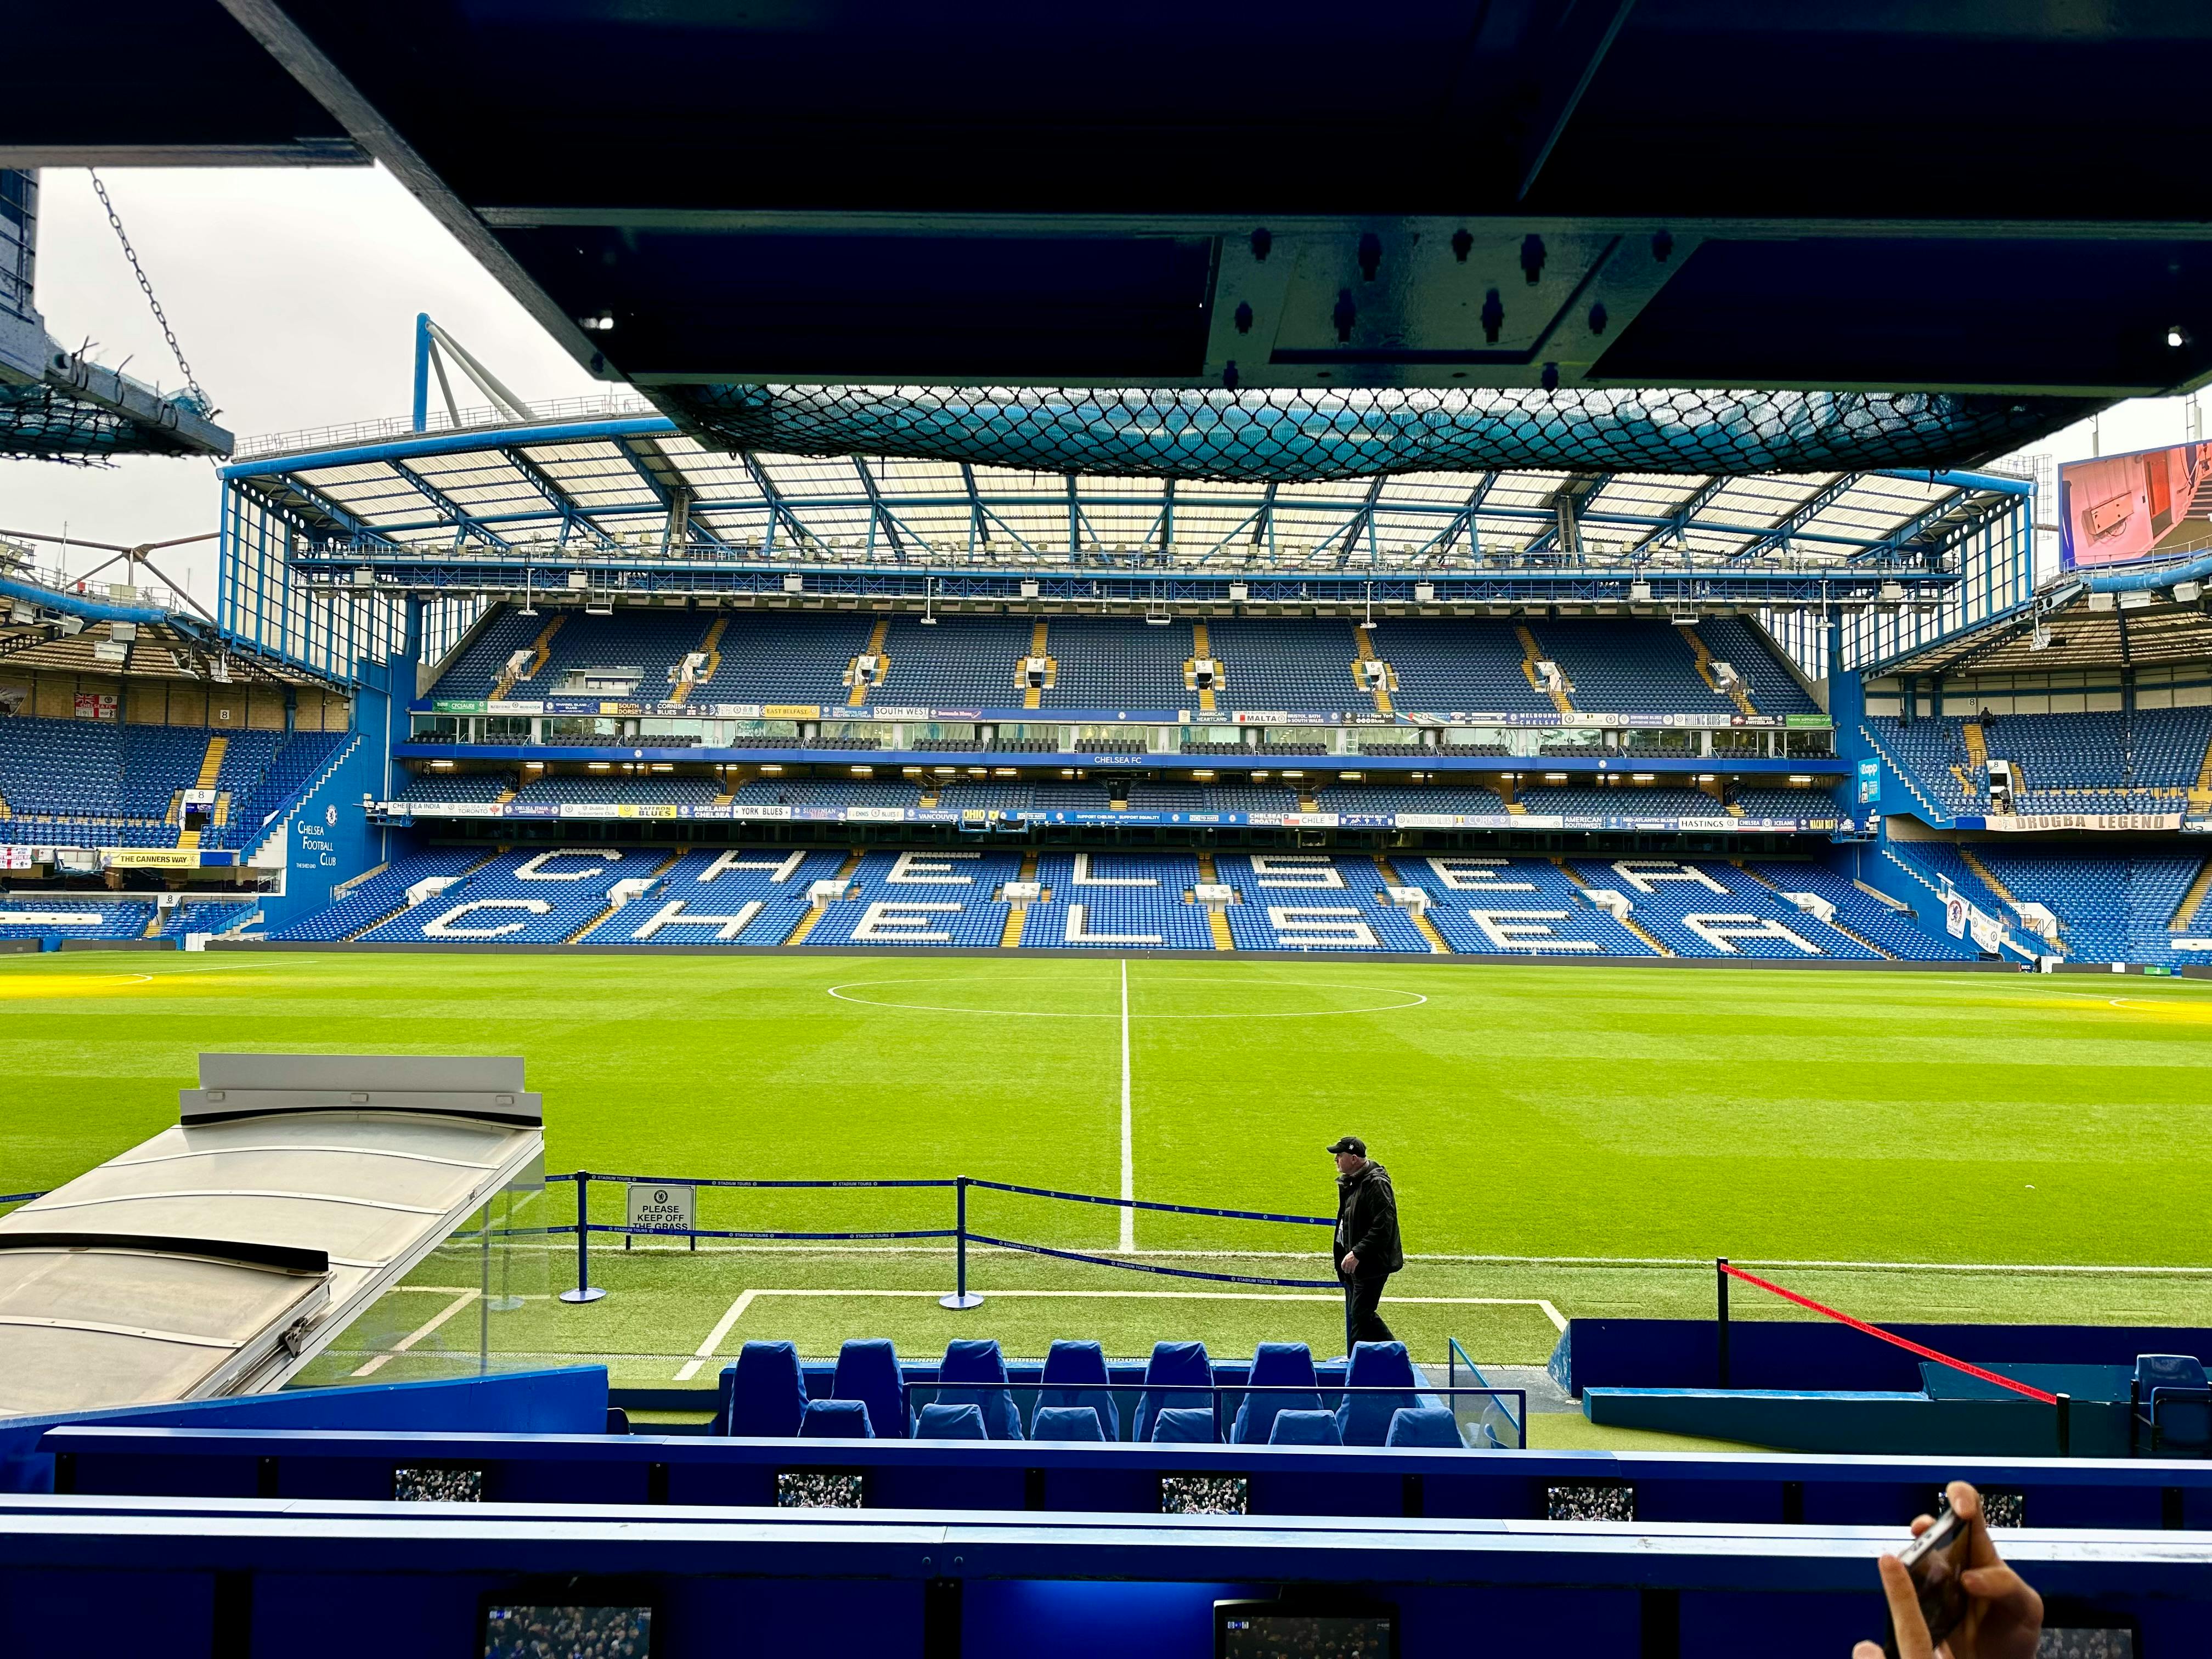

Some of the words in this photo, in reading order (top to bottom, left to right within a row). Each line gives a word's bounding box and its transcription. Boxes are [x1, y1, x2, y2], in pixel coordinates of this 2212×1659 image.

[1685, 714, 1705, 725] HELLENIC
[1707, 714, 1720, 725] BLUES
[963, 809, 985, 820] OHIO
[298, 820, 324, 836] CHELSEA
[1810, 820, 1824, 830] MACAU
[2099, 816, 2164, 829] LEGEND
[303, 836, 334, 851] FOOTBALL
[320, 852, 336, 866] CLUB
[1973, 909, 1987, 922] CYPRUS
[1987, 920, 1999, 929] BLUES
